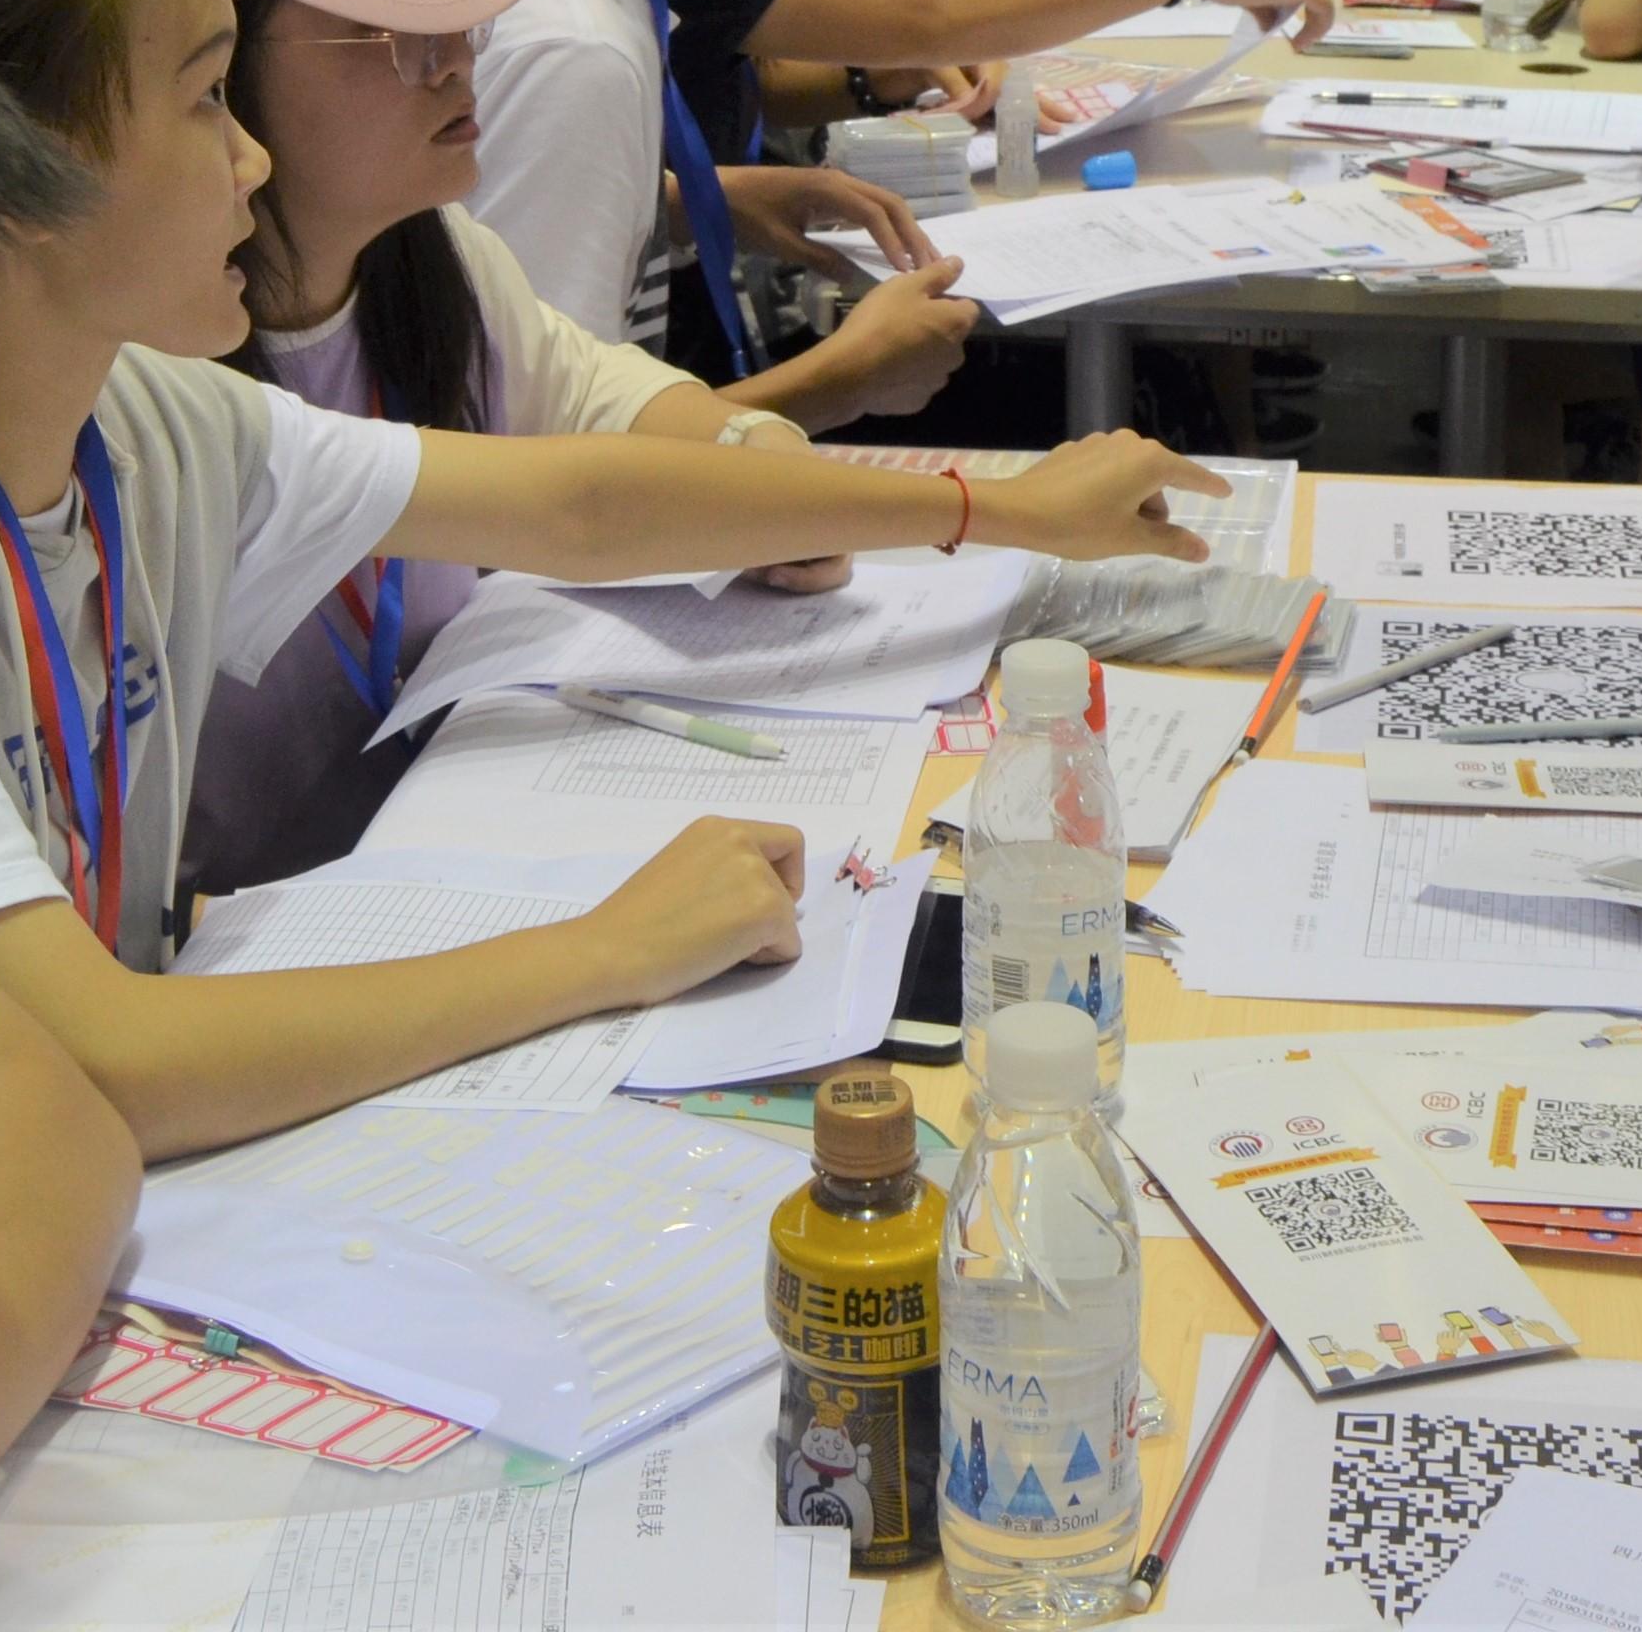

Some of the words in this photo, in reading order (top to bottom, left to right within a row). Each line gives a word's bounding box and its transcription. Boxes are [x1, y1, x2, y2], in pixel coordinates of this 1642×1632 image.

[1292, 1134, 1346, 1152] ICBC
[768, 1262, 926, 1328] 期三的猫
[805, 1328, 926, 1363] 芝士咖啡
[947, 1347, 1048, 1404] ERMA
